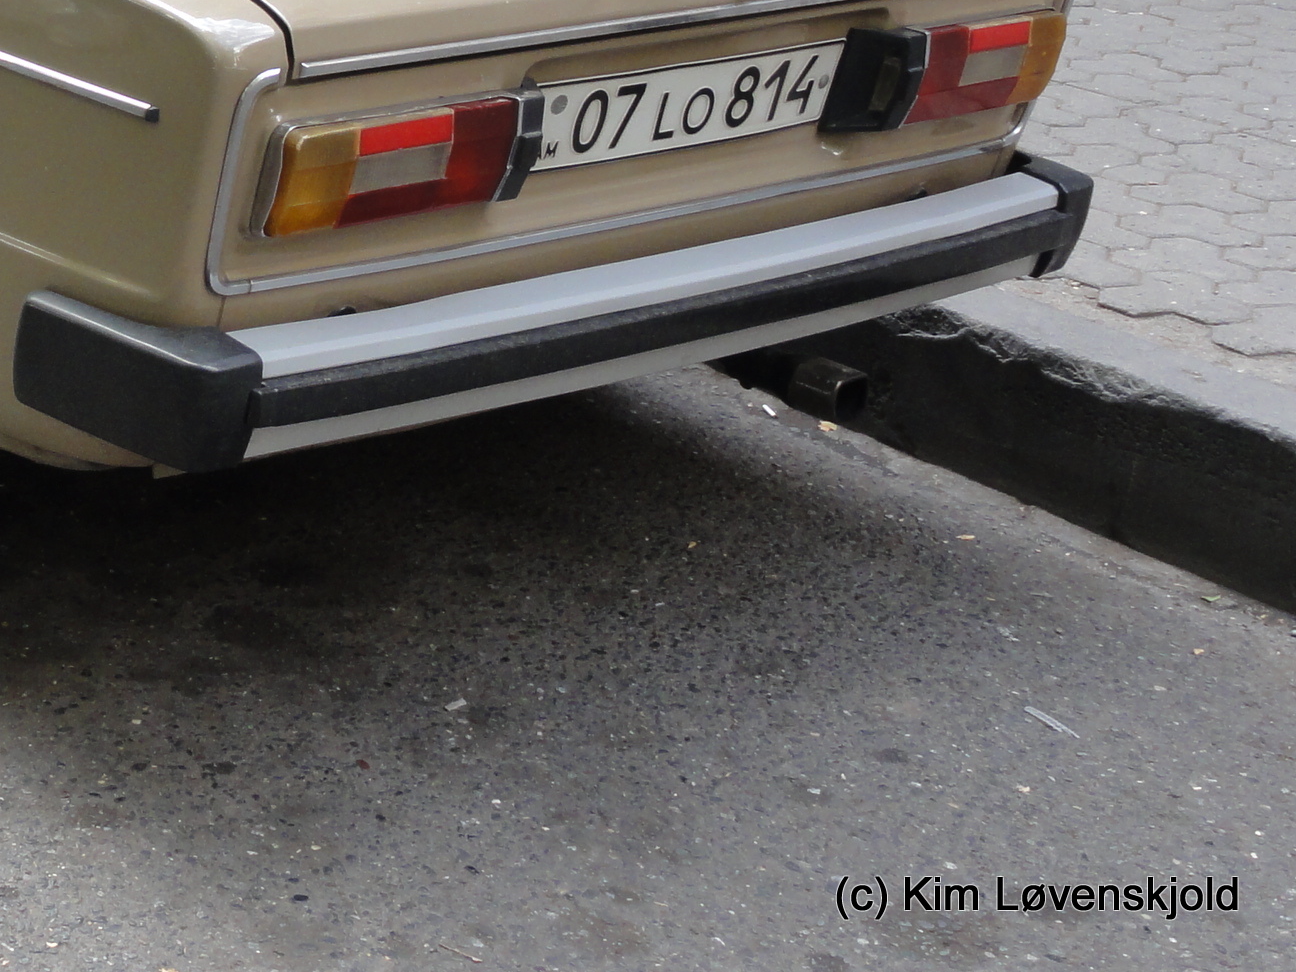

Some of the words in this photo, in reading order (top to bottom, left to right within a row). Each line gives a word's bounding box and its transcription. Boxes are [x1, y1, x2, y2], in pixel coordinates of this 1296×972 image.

[572, 83, 647, 154] 07
[653, 88, 715, 141] LO
[724, 54, 820, 129] 814
[538, 140, 560, 160] M
